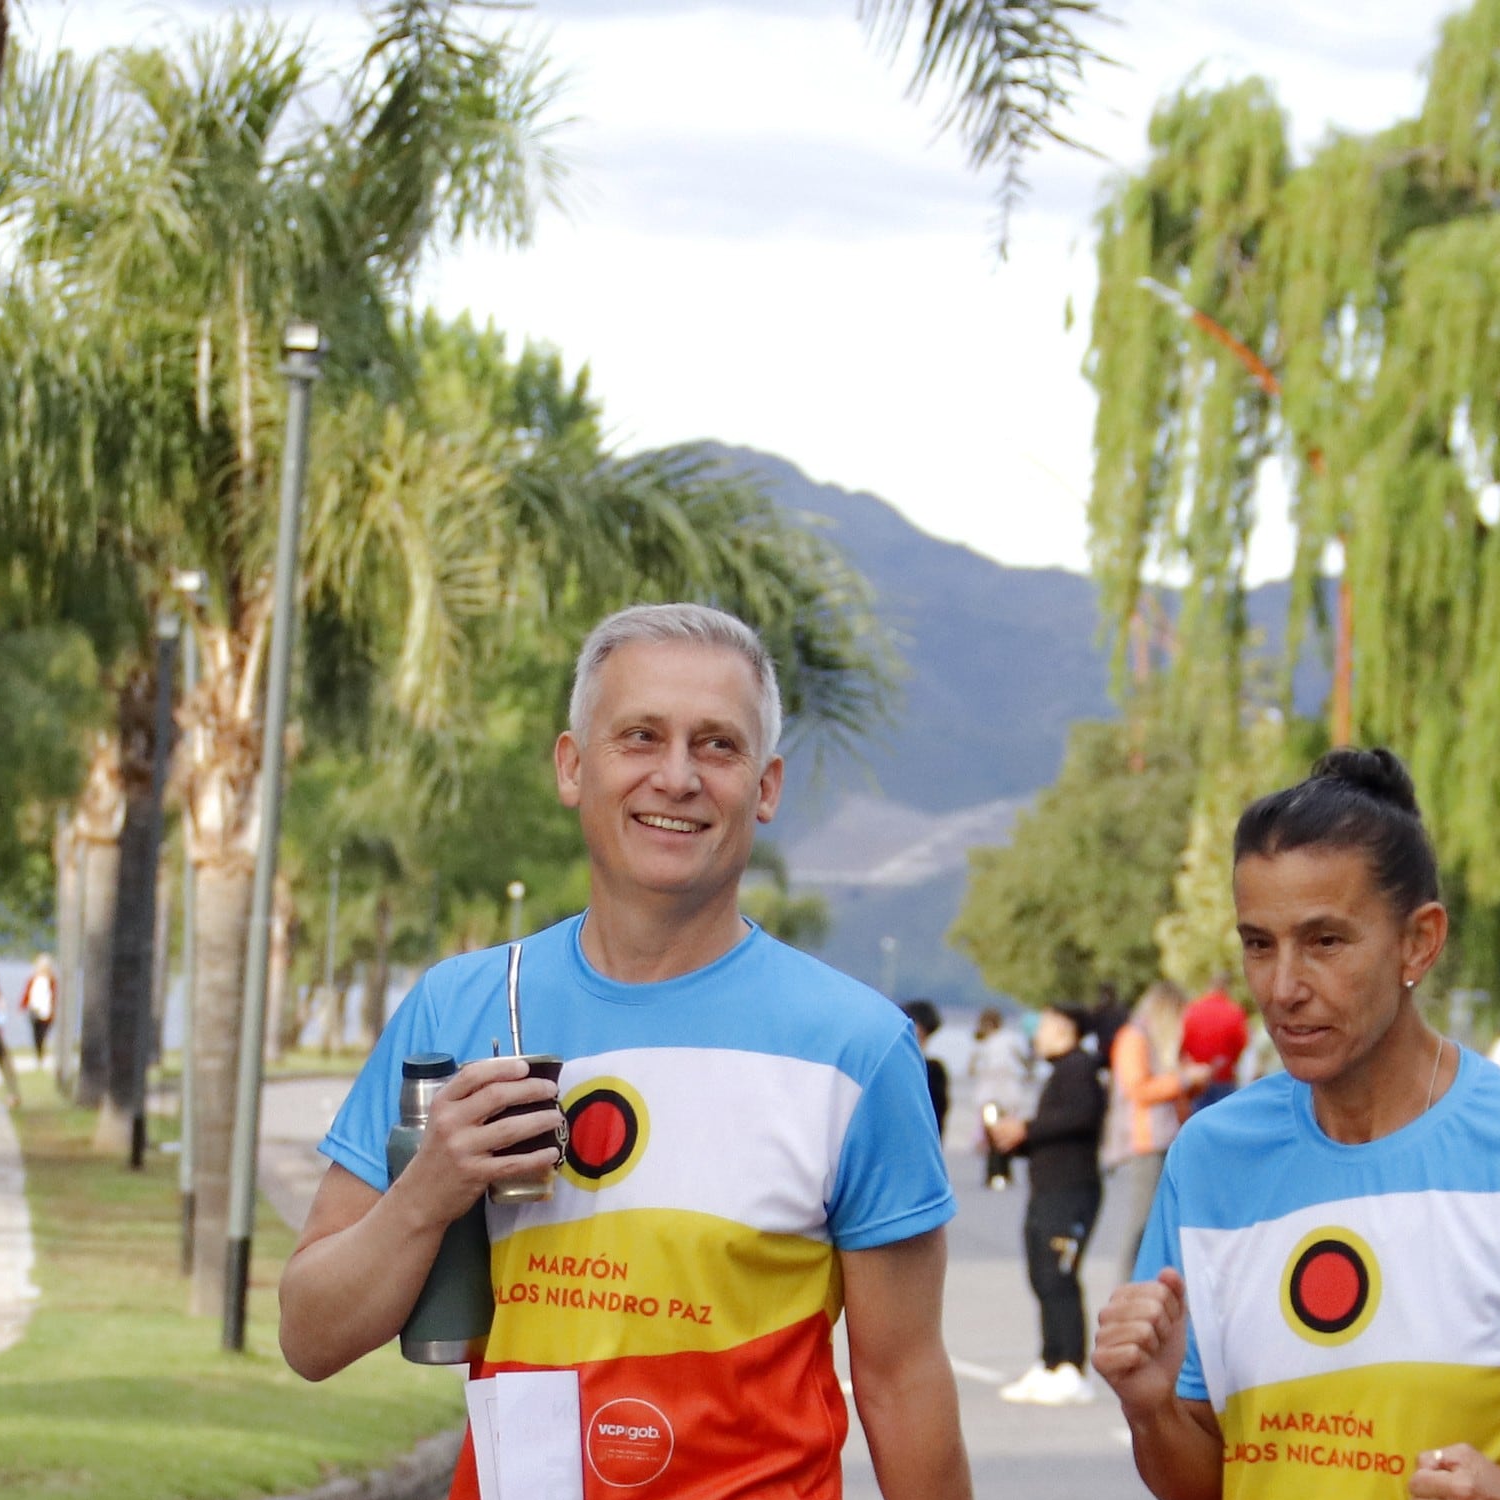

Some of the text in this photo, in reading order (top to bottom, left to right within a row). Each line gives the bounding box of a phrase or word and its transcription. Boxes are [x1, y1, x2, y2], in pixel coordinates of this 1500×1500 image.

[668, 1299, 713, 1325] PAZ
[1260, 1411, 1373, 1438] MARATÓN
[1287, 1444, 1405, 1475] NICANDRO
